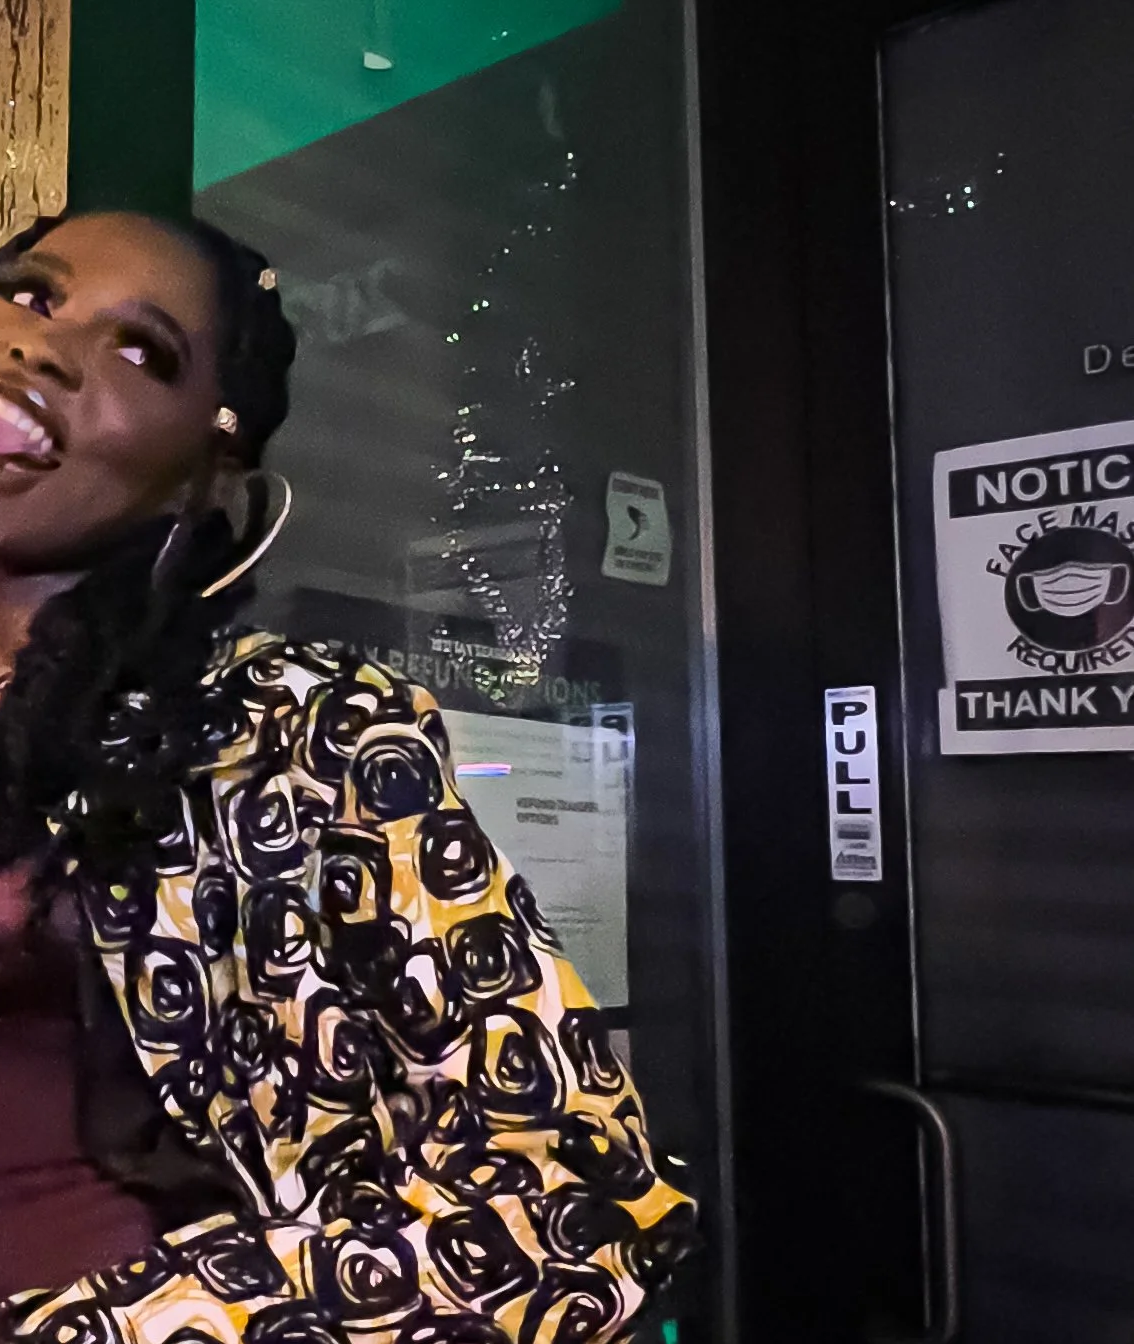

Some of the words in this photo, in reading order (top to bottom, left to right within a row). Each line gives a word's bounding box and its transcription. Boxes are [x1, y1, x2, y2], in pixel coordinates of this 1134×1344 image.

[985, 510, 1060, 578] FACE
[959, 686, 1099, 720] THANK
[831, 700, 874, 815] PULL
